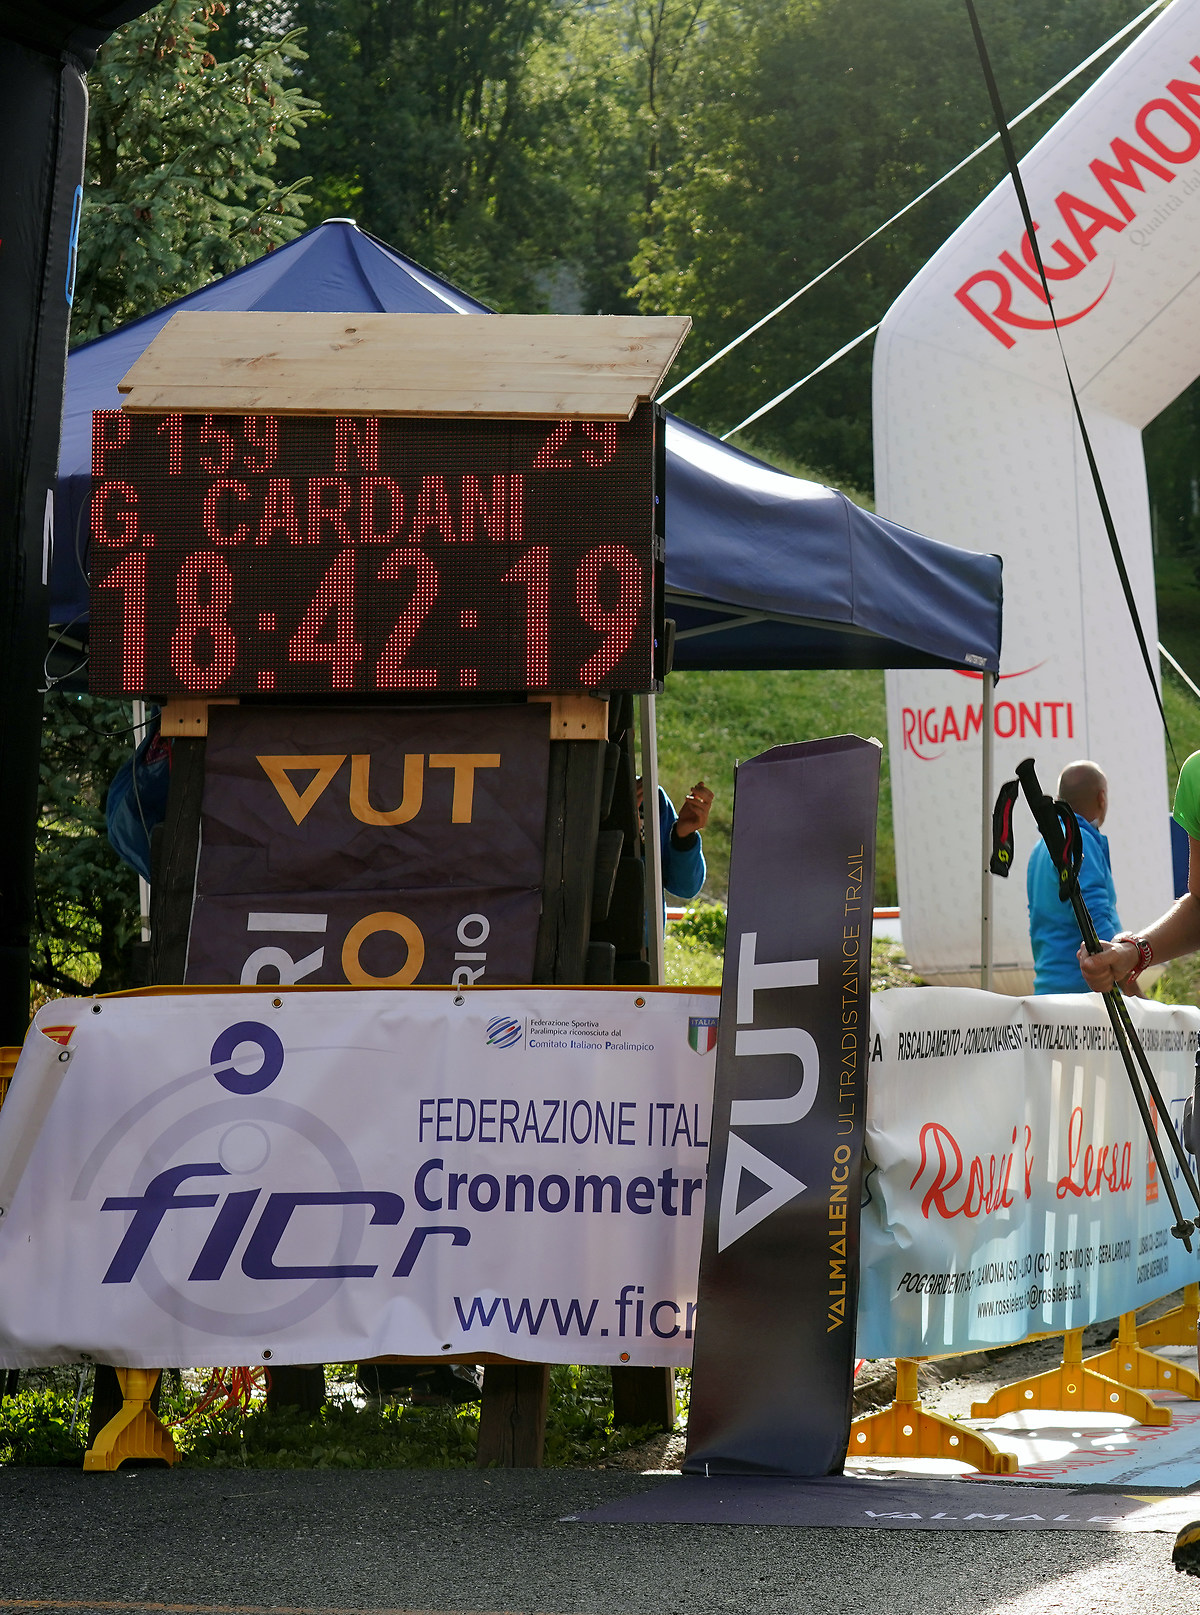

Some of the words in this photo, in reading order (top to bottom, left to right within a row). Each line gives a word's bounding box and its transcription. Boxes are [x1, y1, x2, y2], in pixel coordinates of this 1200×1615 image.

[92, 409, 131, 476] P
[157, 413, 279, 475] 159
[335, 417, 379, 472] N
[91, 480, 156, 547] G.
[203, 474, 524, 545] CARDANI
[98, 544, 643, 691] 18:42:19
[902, 701, 1073, 761] RIGAMONTI
[845, 844, 865, 917] TRAIL
[529, 1039, 568, 1049] Comitato
[570, 1040, 602, 1050] Italiano
[605, 1041, 654, 1052] Paralimpico
[530, 1018, 570, 1027] Federazione
[571, 1019, 599, 1028] Sportiva
[530, 1028, 568, 1038] Paralimpica
[569, 1029, 609, 1037] riconosciuta
[611, 1029, 622, 1037] dal
[838, 925, 861, 1137] ULTRADISTANCE
[869, 1033, 883, 1062] A
[898, 1029, 961, 1062] RISCALDAMENTO
[962, 1024, 1023, 1056] CONDIZIONAMENT
[419, 1099, 637, 1146] FEDERAZIONE
[647, 1102, 709, 1148] ITAL
[413, 1157, 709, 1217] Cronometr
[827, 1144, 851, 1334] VALMALENCO
